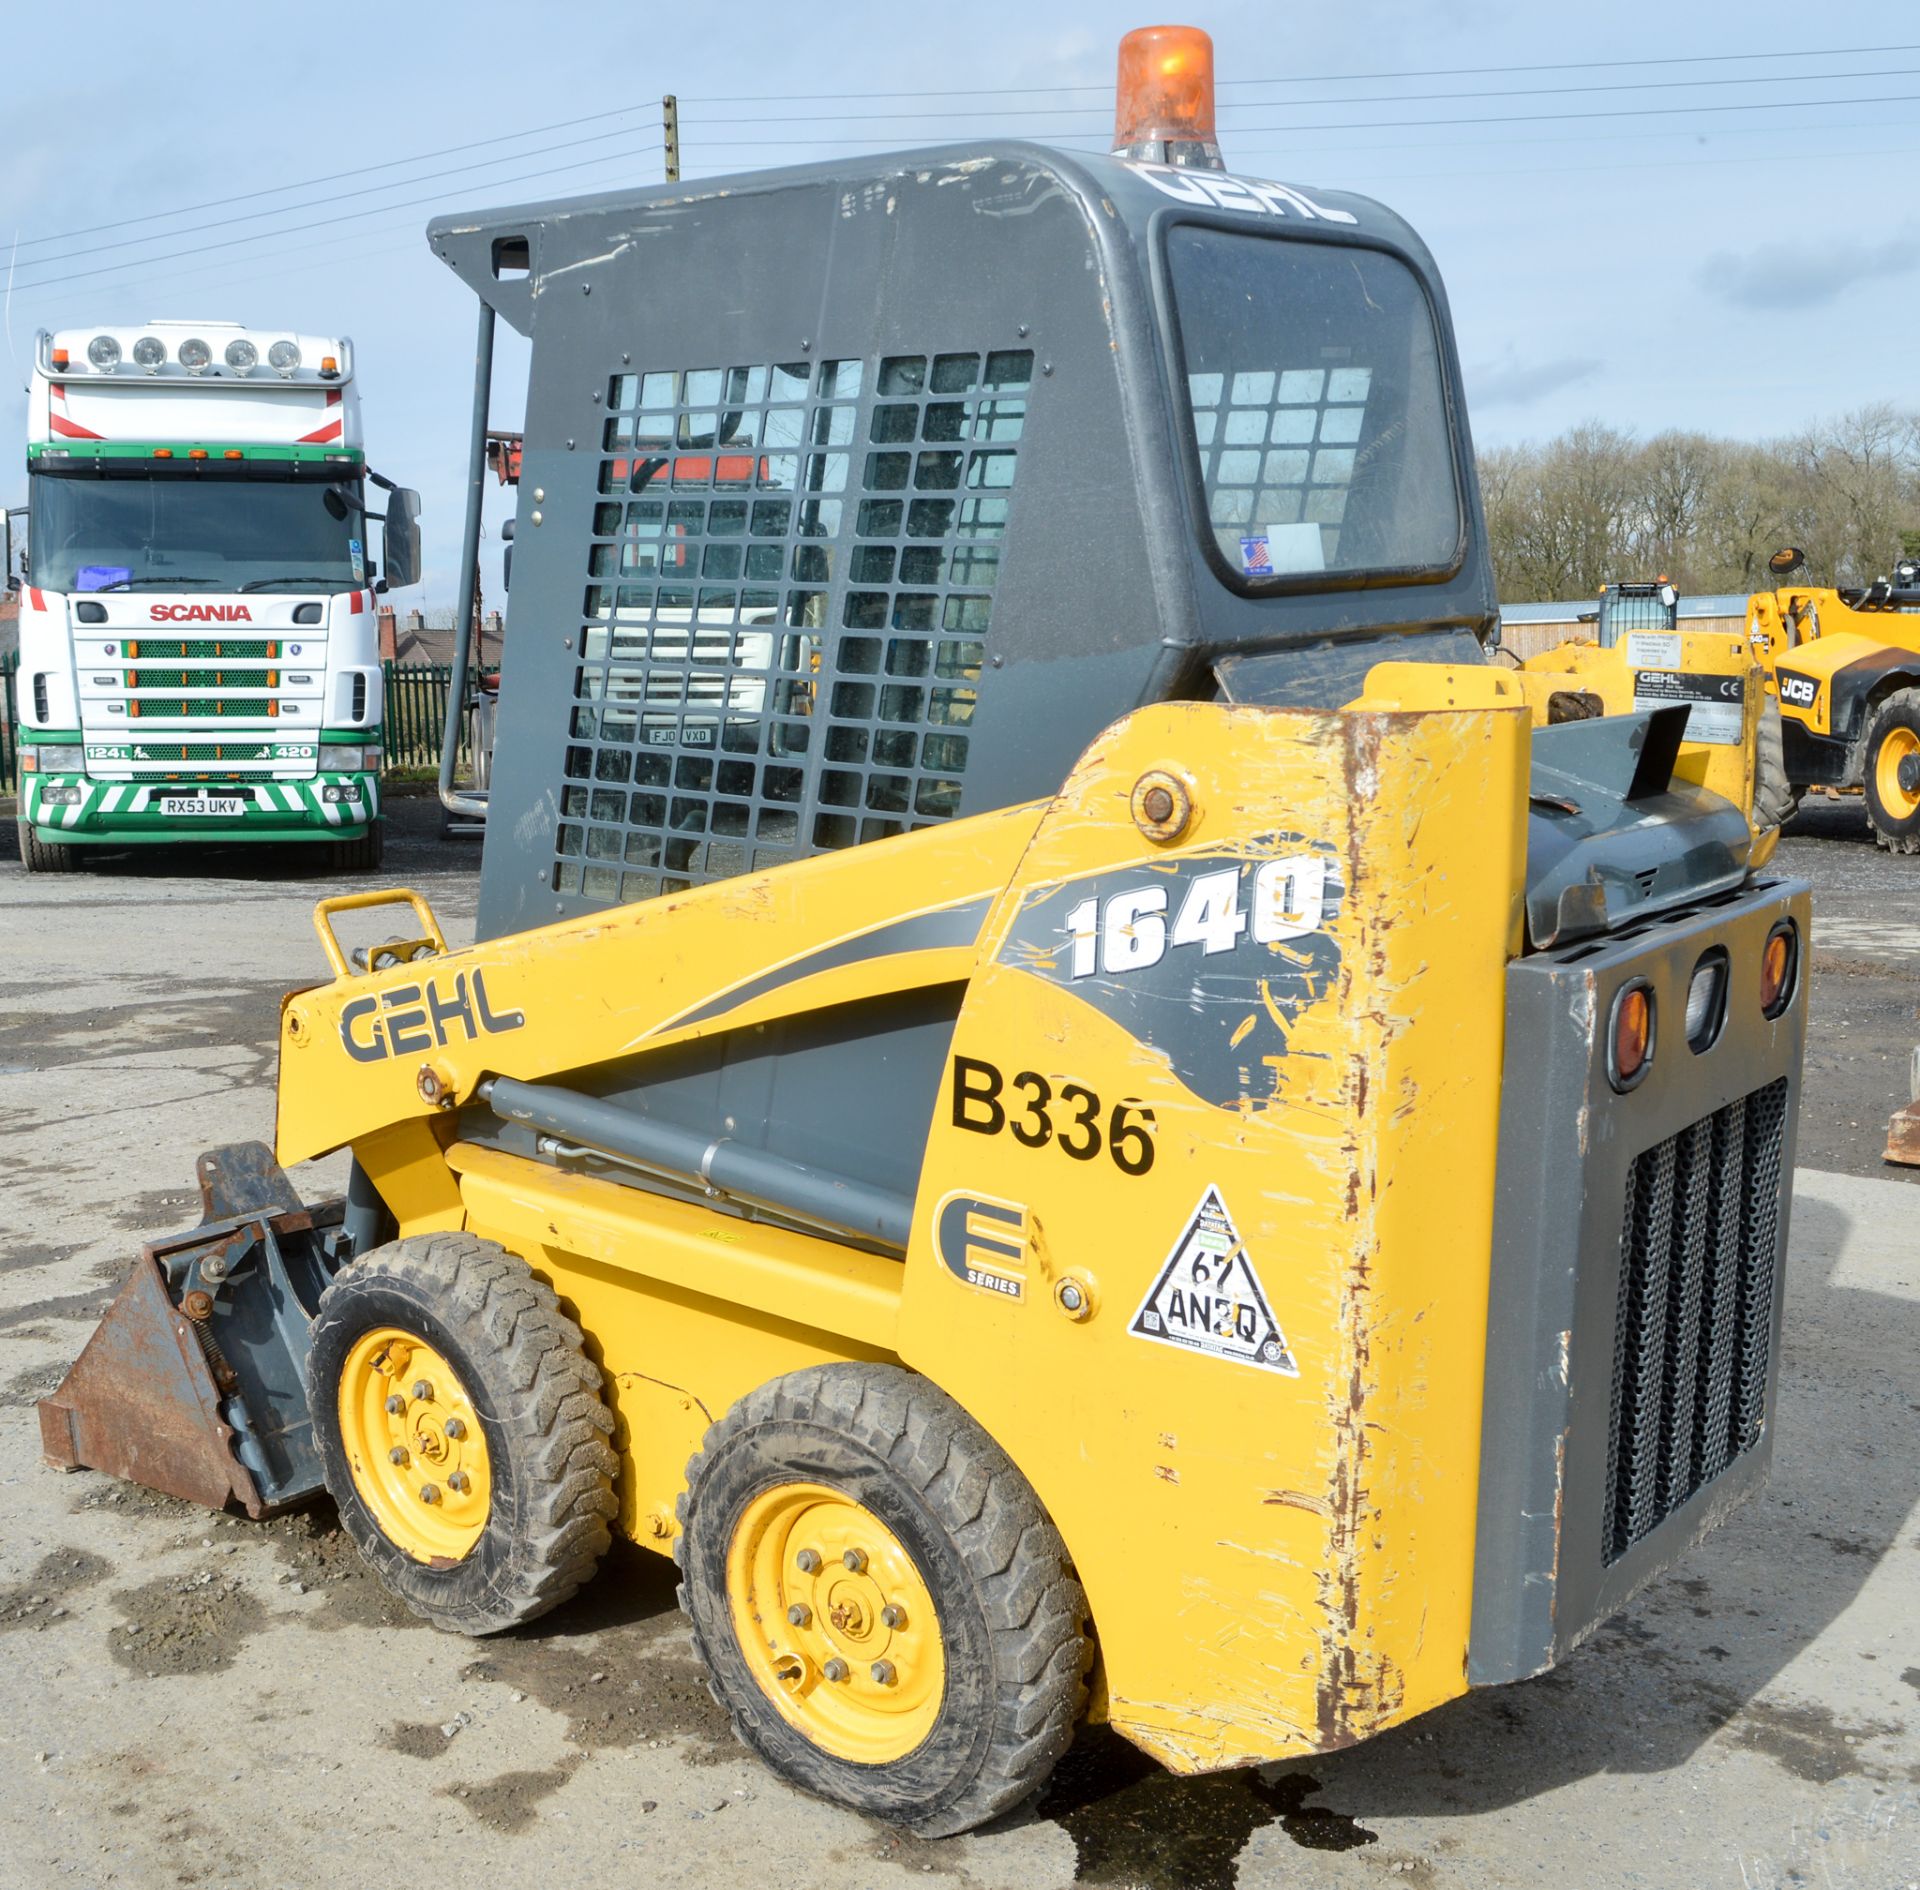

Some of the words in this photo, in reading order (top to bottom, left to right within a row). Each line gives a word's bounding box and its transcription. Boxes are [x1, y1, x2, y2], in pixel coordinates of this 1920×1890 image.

[1123, 163, 1358, 225] GEHL
[149, 604, 253, 622] SCANIA
[1639, 672, 1680, 684] GEHL
[1720, 681, 1740, 697] CE
[1781, 678, 1814, 702] JCB
[654, 731, 677, 742] FJ0
[686, 730, 706, 741] VXD
[276, 746, 312, 758] 420
[167, 800, 206, 813] RX53
[209, 800, 237, 813] UKV
[1064, 853, 1325, 980] 1640
[338, 967, 526, 1064] GEHL
[952, 1054, 1156, 1177] B336
[936, 1193, 1025, 1300] E
[966, 1268, 1019, 1295] SERIES
[1191, 1251, 1234, 1294] 67
